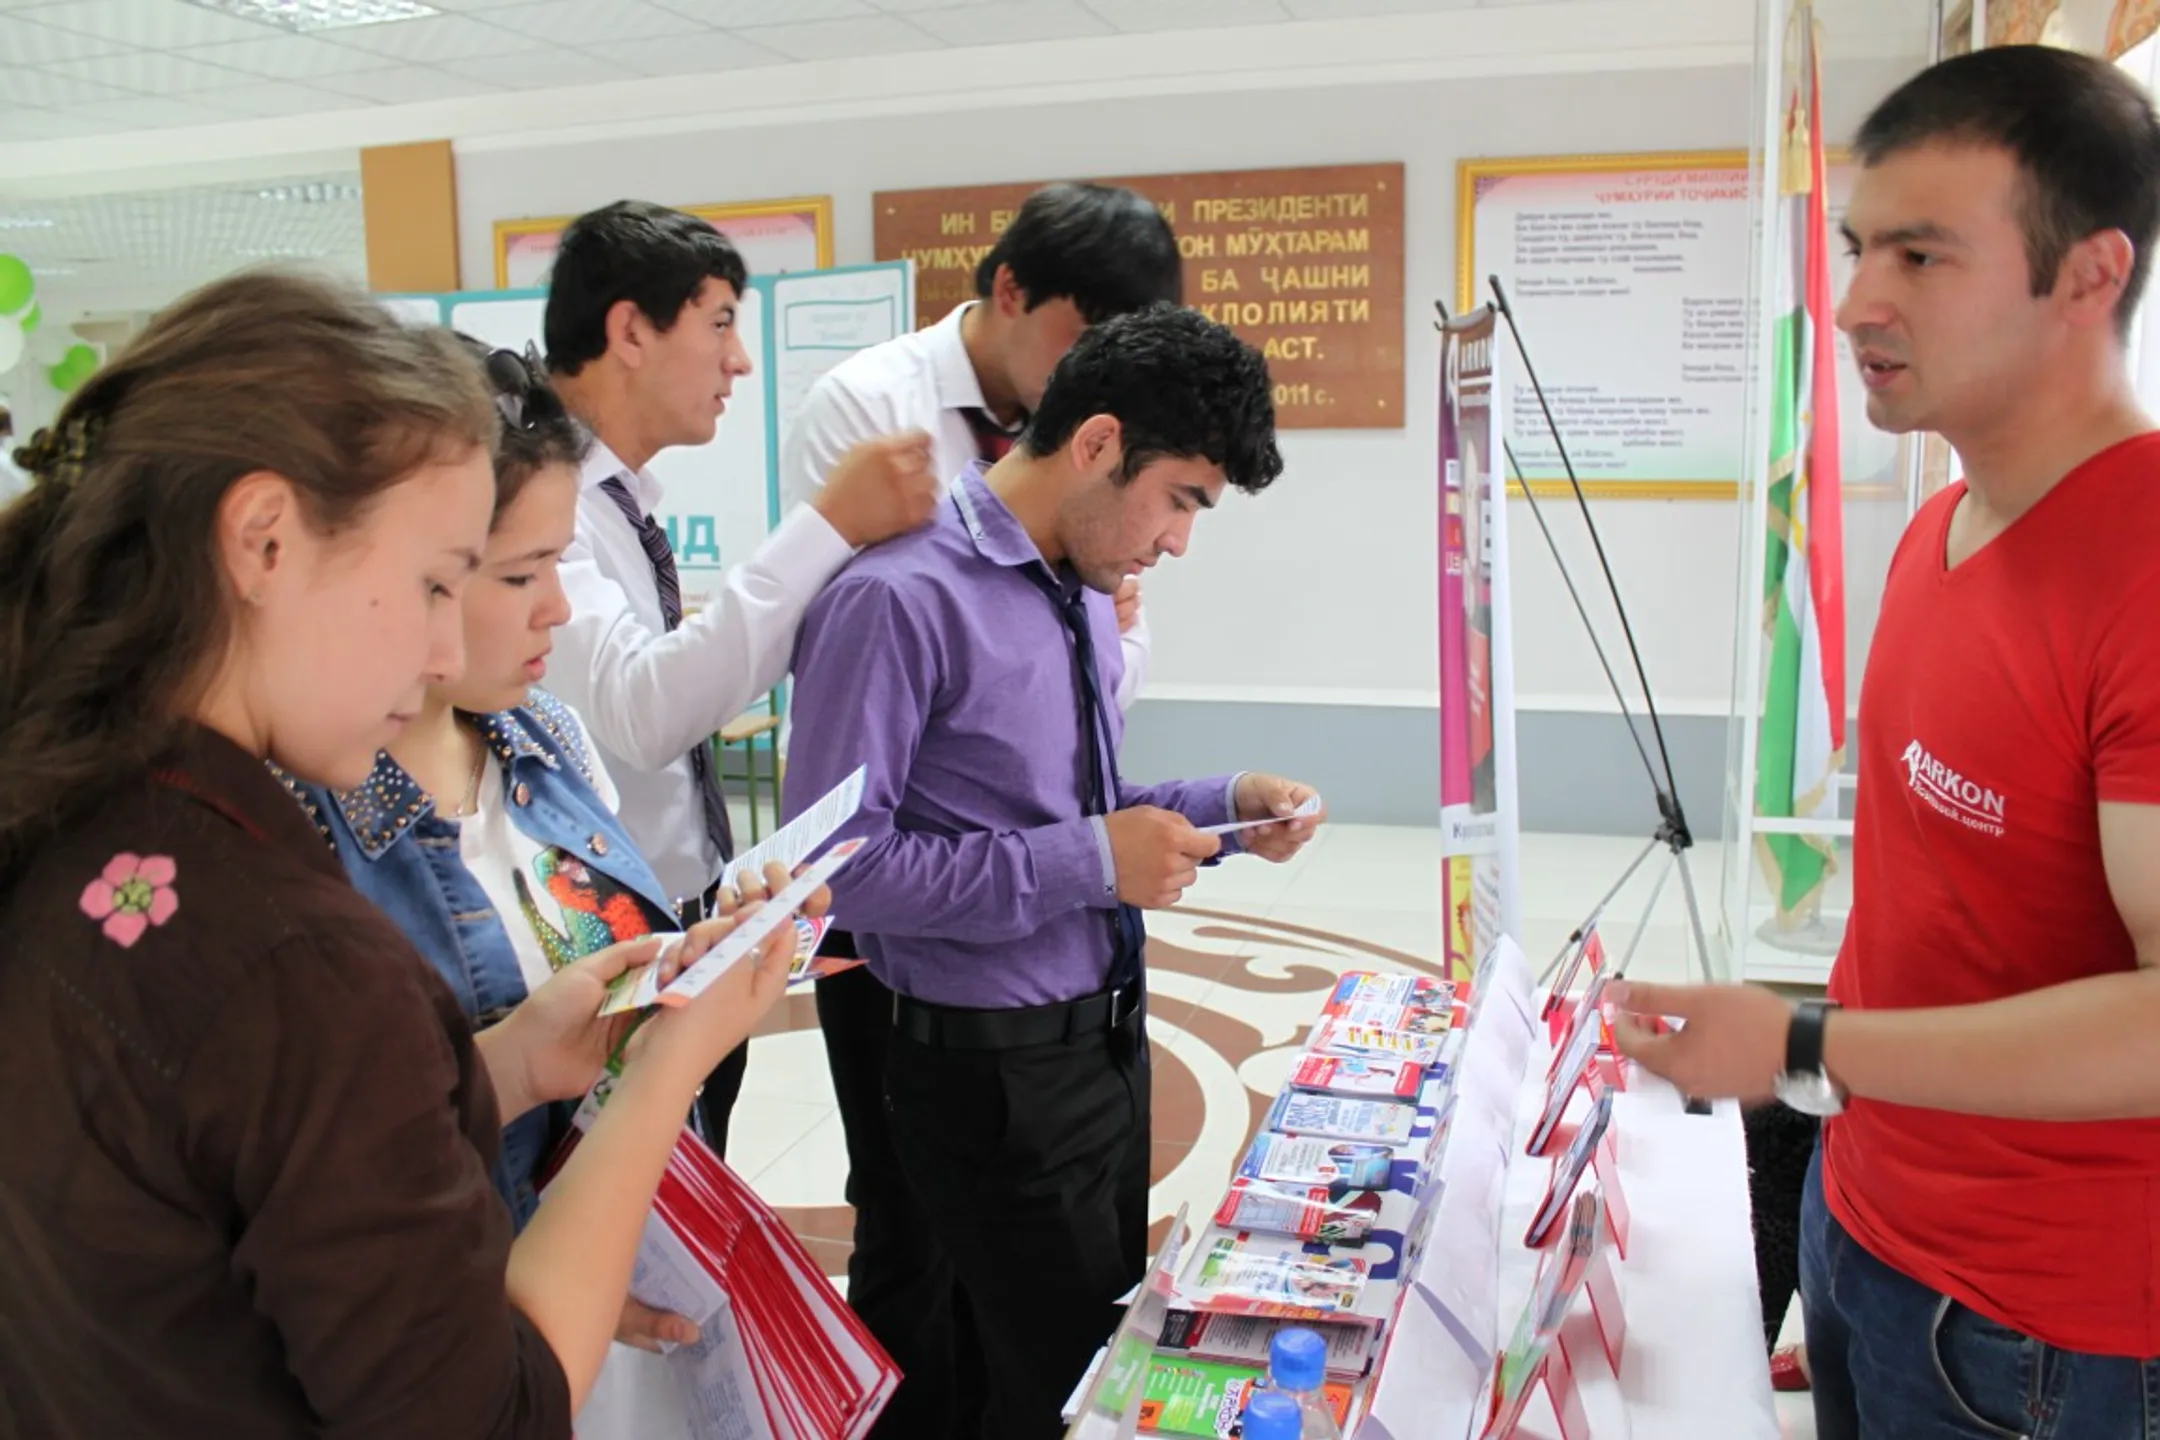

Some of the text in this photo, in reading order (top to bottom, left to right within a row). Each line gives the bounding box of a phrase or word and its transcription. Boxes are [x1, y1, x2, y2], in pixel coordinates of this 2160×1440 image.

[941, 212, 976, 235] ИН
[1193, 193, 1369, 224] ПРЕЗИДЕНТИ
[1202, 267, 1241, 293] БА
[1263, 335, 1325, 361] АСТ.
[1920, 751, 2005, 817] ARKON
